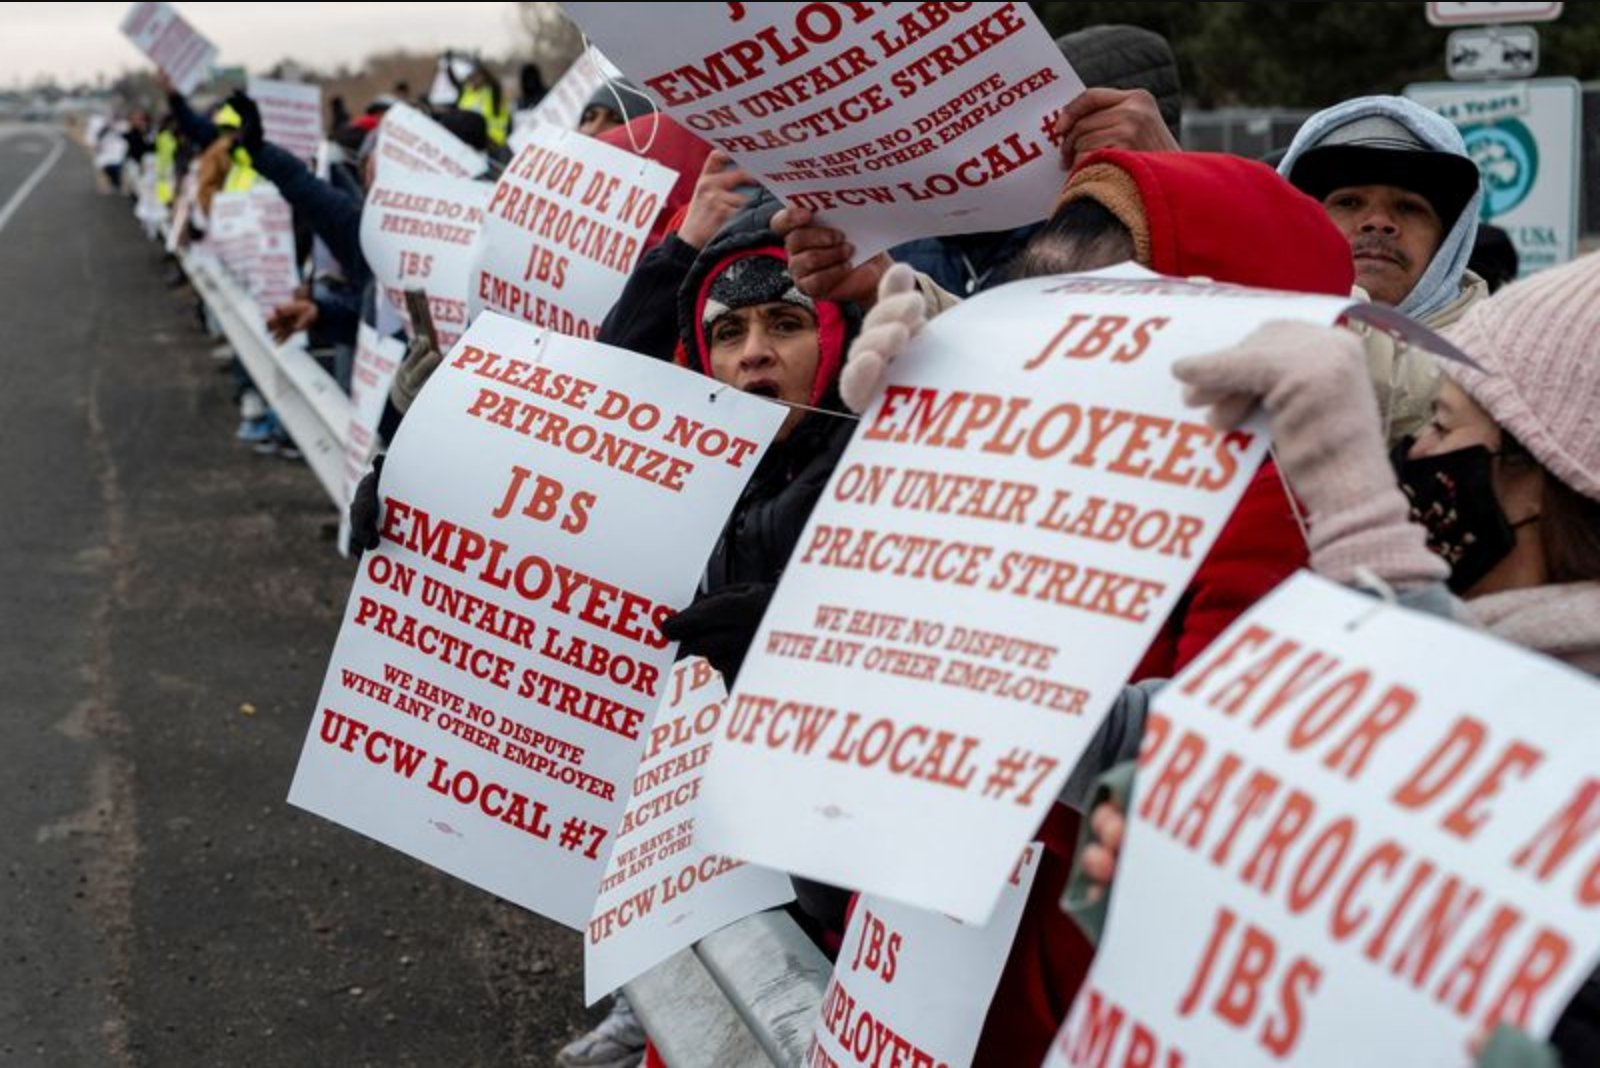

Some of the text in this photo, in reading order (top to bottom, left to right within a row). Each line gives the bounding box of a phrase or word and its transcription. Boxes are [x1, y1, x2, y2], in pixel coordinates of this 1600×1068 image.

[643, 2, 878, 106] EMPLO
[686, 2, 973, 133] ON UNFAIR LABO
[717, 3, 1027, 154] PRACTICE STRIKE
[764, 66, 1060, 186] WITH ANY OTHER EMPLOYER
[785, 73, 1007, 171] WE HAVE NO DISPUTE
[371, 188, 434, 215] PLEASE
[435, 198, 462, 220] DO
[509, 143, 658, 230] FAVOR DE NO
[785, 182, 900, 216] UFCW
[900, 132, 1043, 202] LOCAL
[380, 214, 476, 245] PATRONIZE
[397, 250, 434, 281] JBS
[488, 181, 638, 275] PRATROCINAR
[524, 243, 570, 290] JBS
[1023, 313, 1173, 371] JBS
[451, 344, 597, 412] PLEASE
[593, 389, 661, 432] DO
[662, 415, 759, 469] NOT
[466, 387, 695, 492] PATRONIZE
[861, 384, 1256, 493] EMPLOYEES
[492, 464, 598, 535] JBS
[832, 463, 1206, 559] ON UNFAIR LABOR
[379, 496, 676, 650] EMPLOYEES
[800, 524, 1166, 624] PRACTICE STRIKE
[353, 596, 516, 690] PRACTICE
[517, 668, 646, 741] STRIKE
[367, 554, 660, 698] ON UNFAIR LABOR
[766, 630, 1092, 716] WITH ANY OTHER EMPLOYER
[813, 603, 1059, 672] WE HAVE NO DISPUTE
[382, 663, 586, 766] WE HAVE NO DISPUTE
[670, 659, 713, 707] JB
[1179, 621, 1421, 782] FAVOR
[1391, 713, 1546, 842] DE
[318, 708, 609, 861] UFCW LOCAL #7
[341, 669, 617, 803] WITH ANY OTHER EMPLOYER
[725, 692, 839, 756] UFCW
[827, 711, 981, 790] LOCAL
[981, 747, 1059, 808] #7
[598, 868, 627, 895] ITH
[627, 851, 657, 880] ANY
[616, 847, 639, 868] WE
[639, 829, 675, 858] HAVE
[1137, 709, 1575, 1056] PRATROCINAR
[588, 854, 749, 945] UFCW LOCA
[852, 909, 903, 984] JBS
[1177, 906, 1325, 1060] JBS
